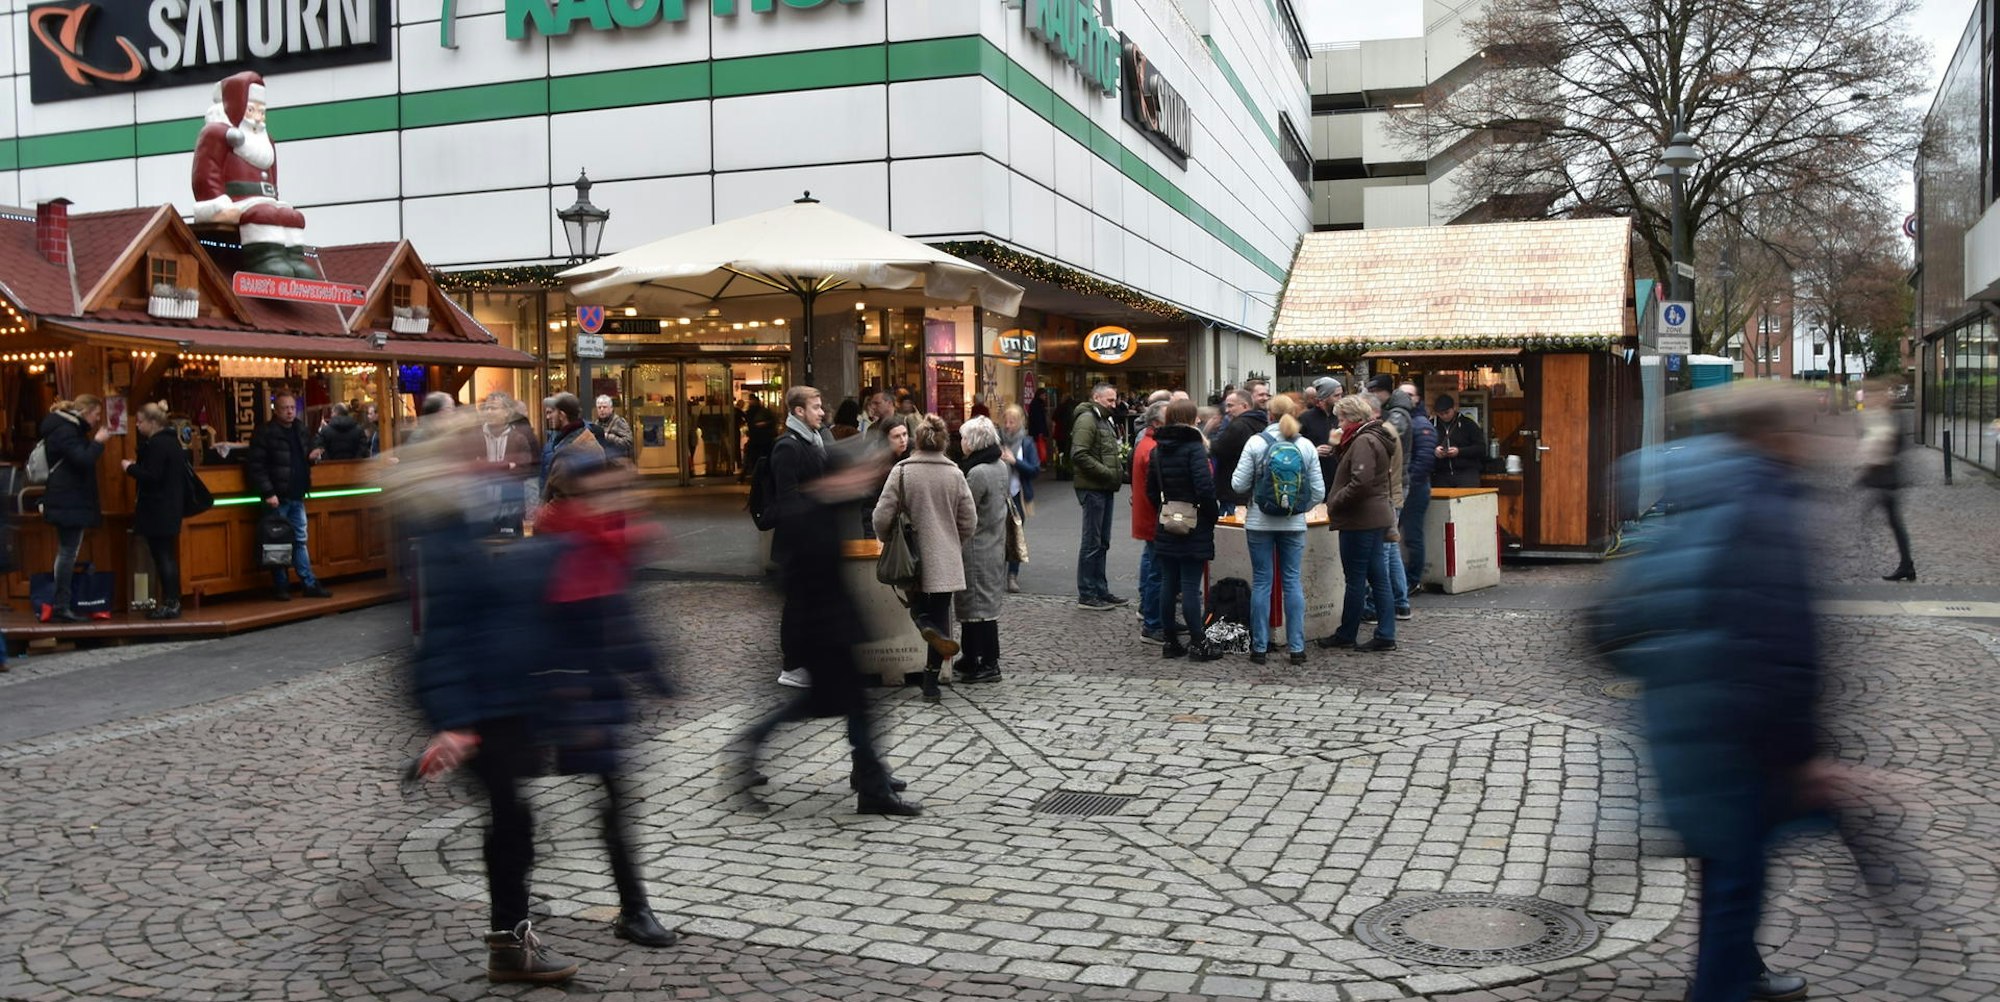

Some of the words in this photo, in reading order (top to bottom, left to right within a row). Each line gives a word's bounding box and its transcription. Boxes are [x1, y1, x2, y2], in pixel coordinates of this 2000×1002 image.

[148, 0, 374, 72] SATURN
[1153, 73, 1193, 158] SATURN
[617, 320, 659, 333] SATURN
[1089, 332, 1131, 351] Curry
